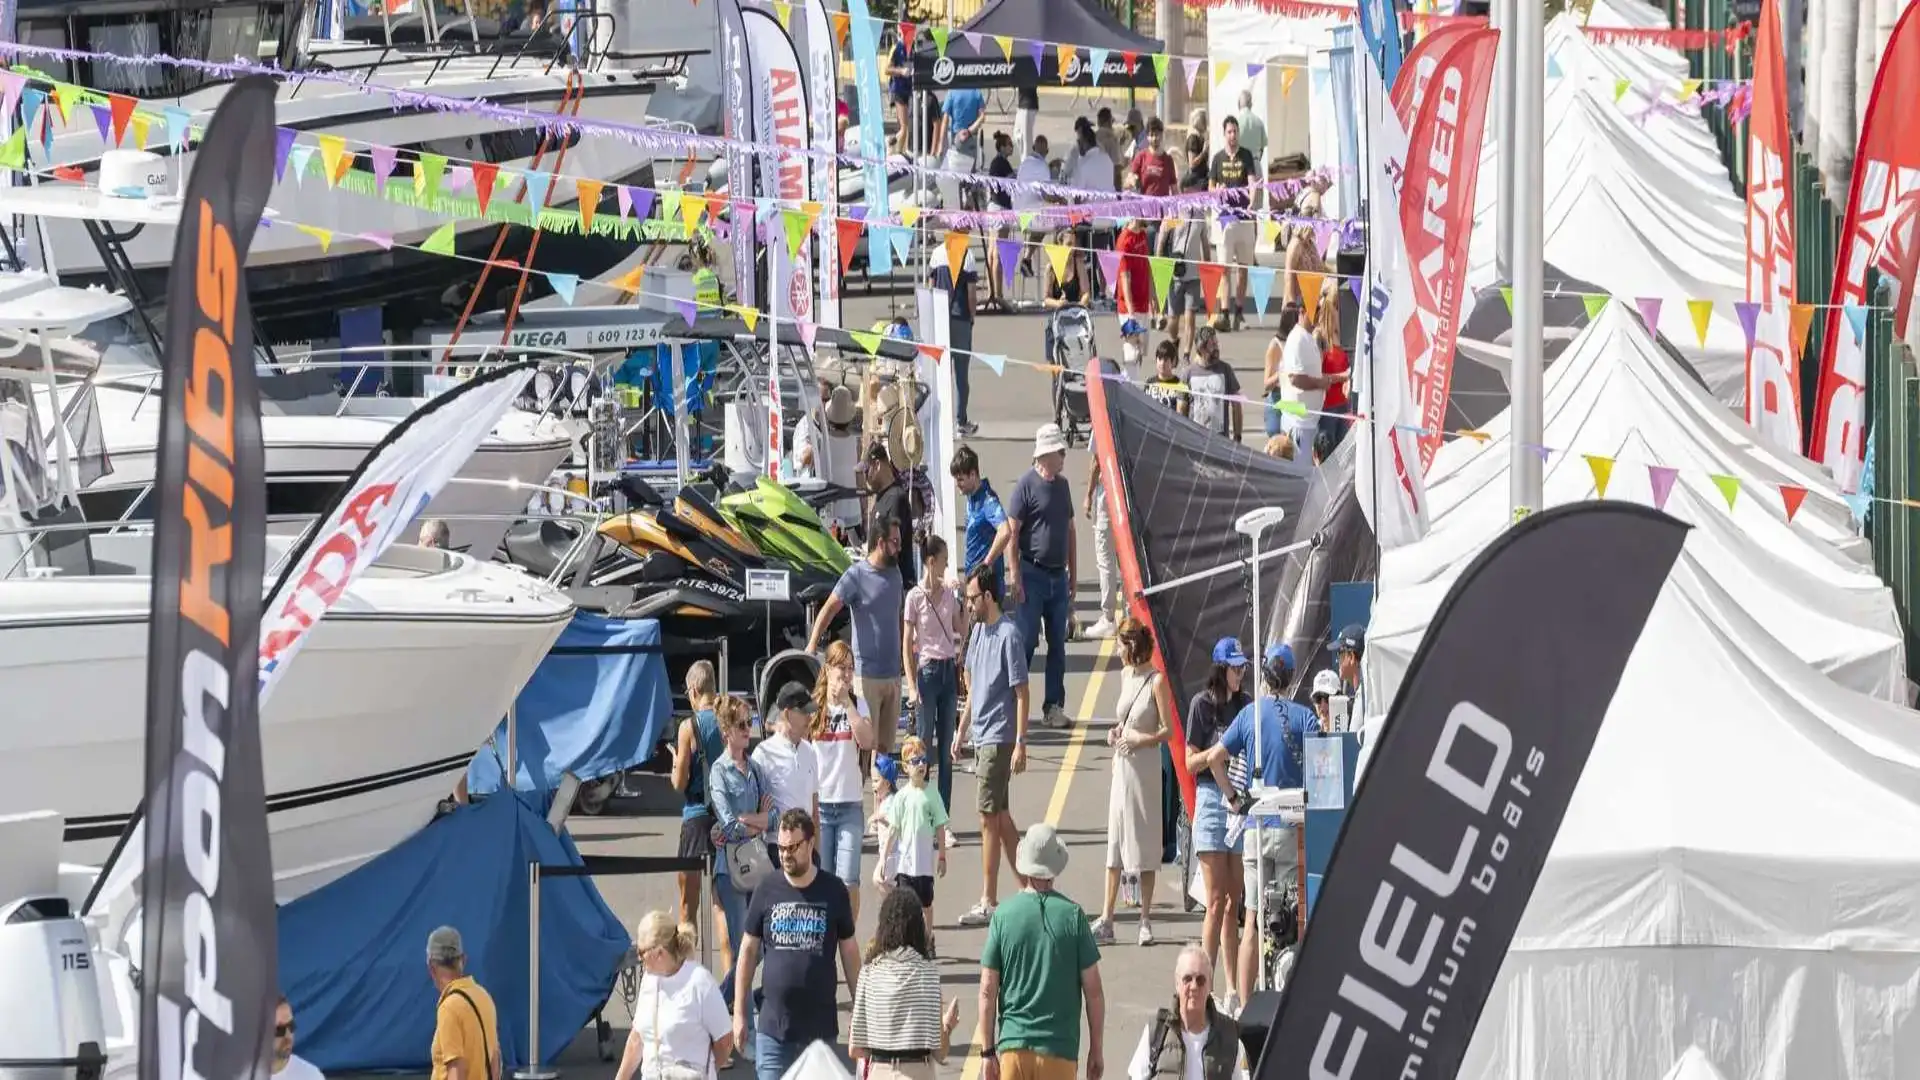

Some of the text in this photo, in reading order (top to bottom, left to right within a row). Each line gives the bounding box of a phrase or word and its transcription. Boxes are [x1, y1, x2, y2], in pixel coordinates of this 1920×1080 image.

[956, 62, 1015, 76] MERCURY
[513, 331, 567, 347] VEGA
[598, 330, 620, 343] 609
[625, 329, 646, 341] 123
[1428, 355, 1448, 438] about
[1471, 745, 1545, 895] boats
[1309, 700, 1513, 1080] FIELD
[771, 908, 827, 921] ORIGINALS
[770, 919, 827, 932] ORIGINALS
[771, 931, 825, 945] ORIGINALS
[62, 953, 89, 970] 115
